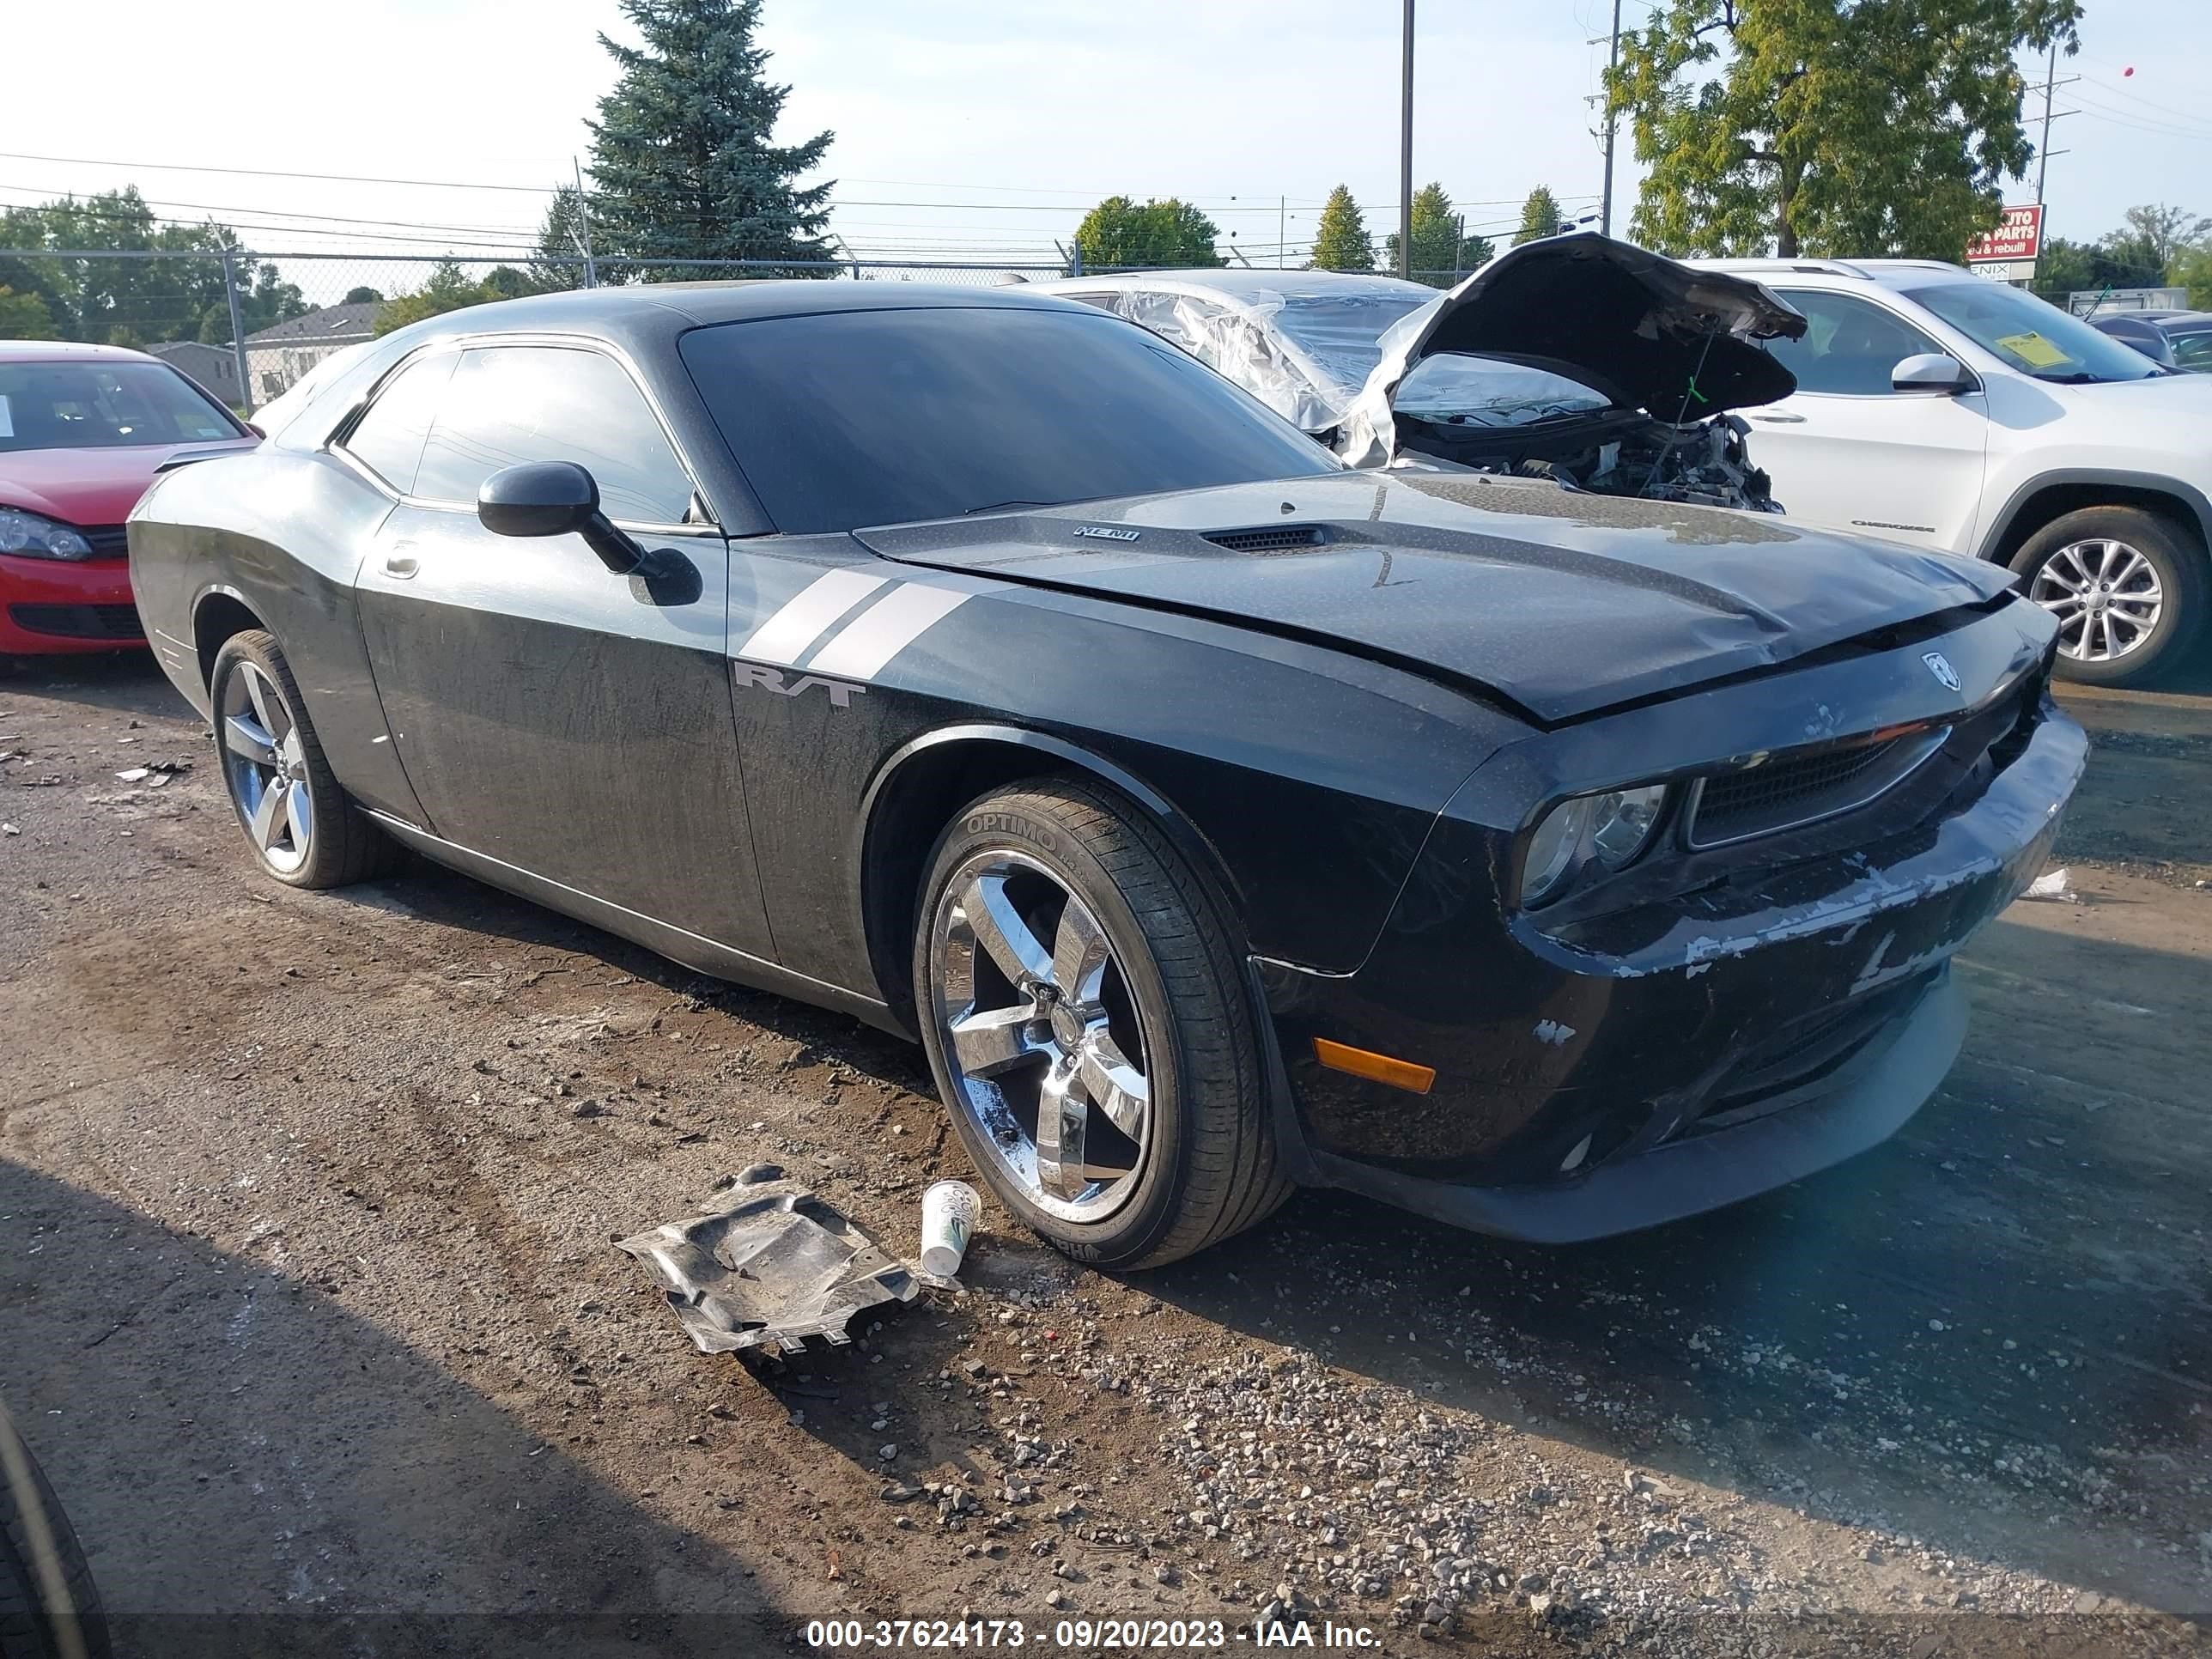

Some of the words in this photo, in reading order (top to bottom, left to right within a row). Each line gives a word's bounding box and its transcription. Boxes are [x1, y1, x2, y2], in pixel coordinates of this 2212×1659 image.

[2002, 211, 2033, 226] UTO
[1994, 225, 2035, 240] PARTS
[1984, 244, 1991, 254] &
[1994, 242, 2026, 254] rebuilt
[1970, 264, 2008, 274] ENIX
[1073, 526, 1140, 542] HEMI
[734, 661, 866, 708] R/T
[967, 813, 1058, 852] OPTIMO
